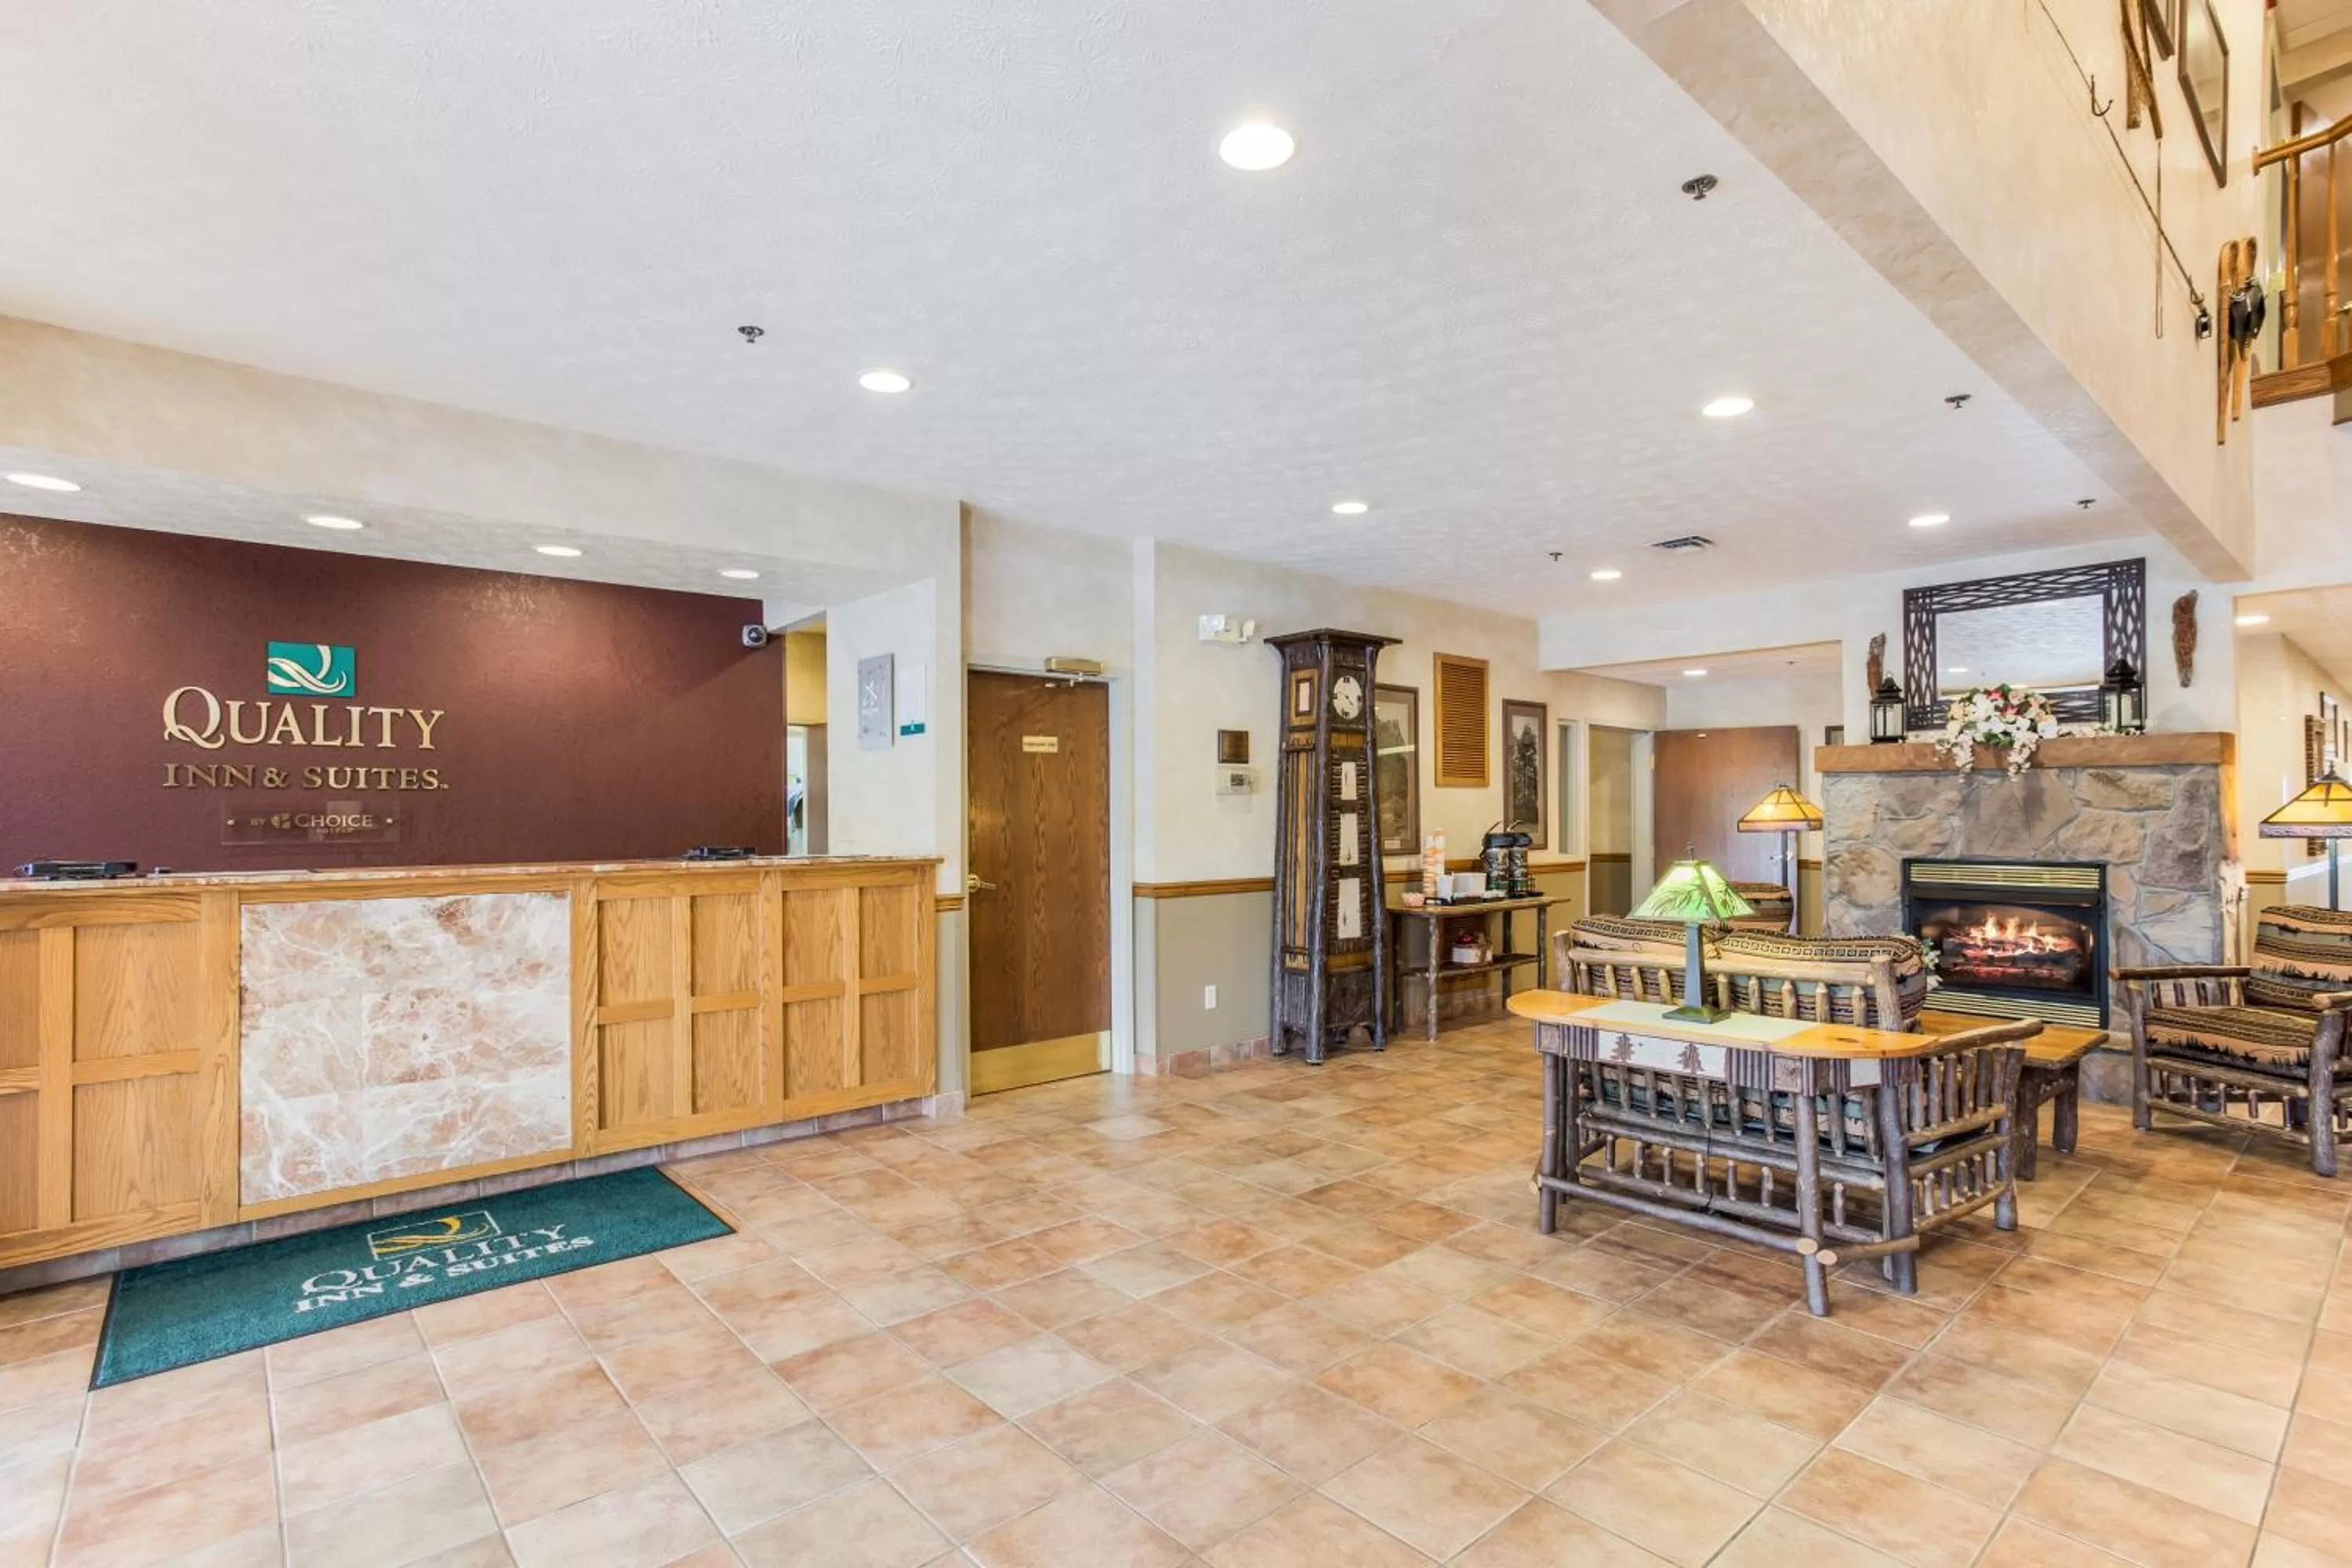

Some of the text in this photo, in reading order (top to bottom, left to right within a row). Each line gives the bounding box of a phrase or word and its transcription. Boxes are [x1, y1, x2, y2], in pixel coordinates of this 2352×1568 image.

[162, 686, 445, 750] QUALITY
[162, 763, 440, 790] INN & SUITES
[294, 814, 373, 828] CHOICE
[294, 1236, 595, 1313] INN & SUITES
[302, 1224, 565, 1296] QUALITY
